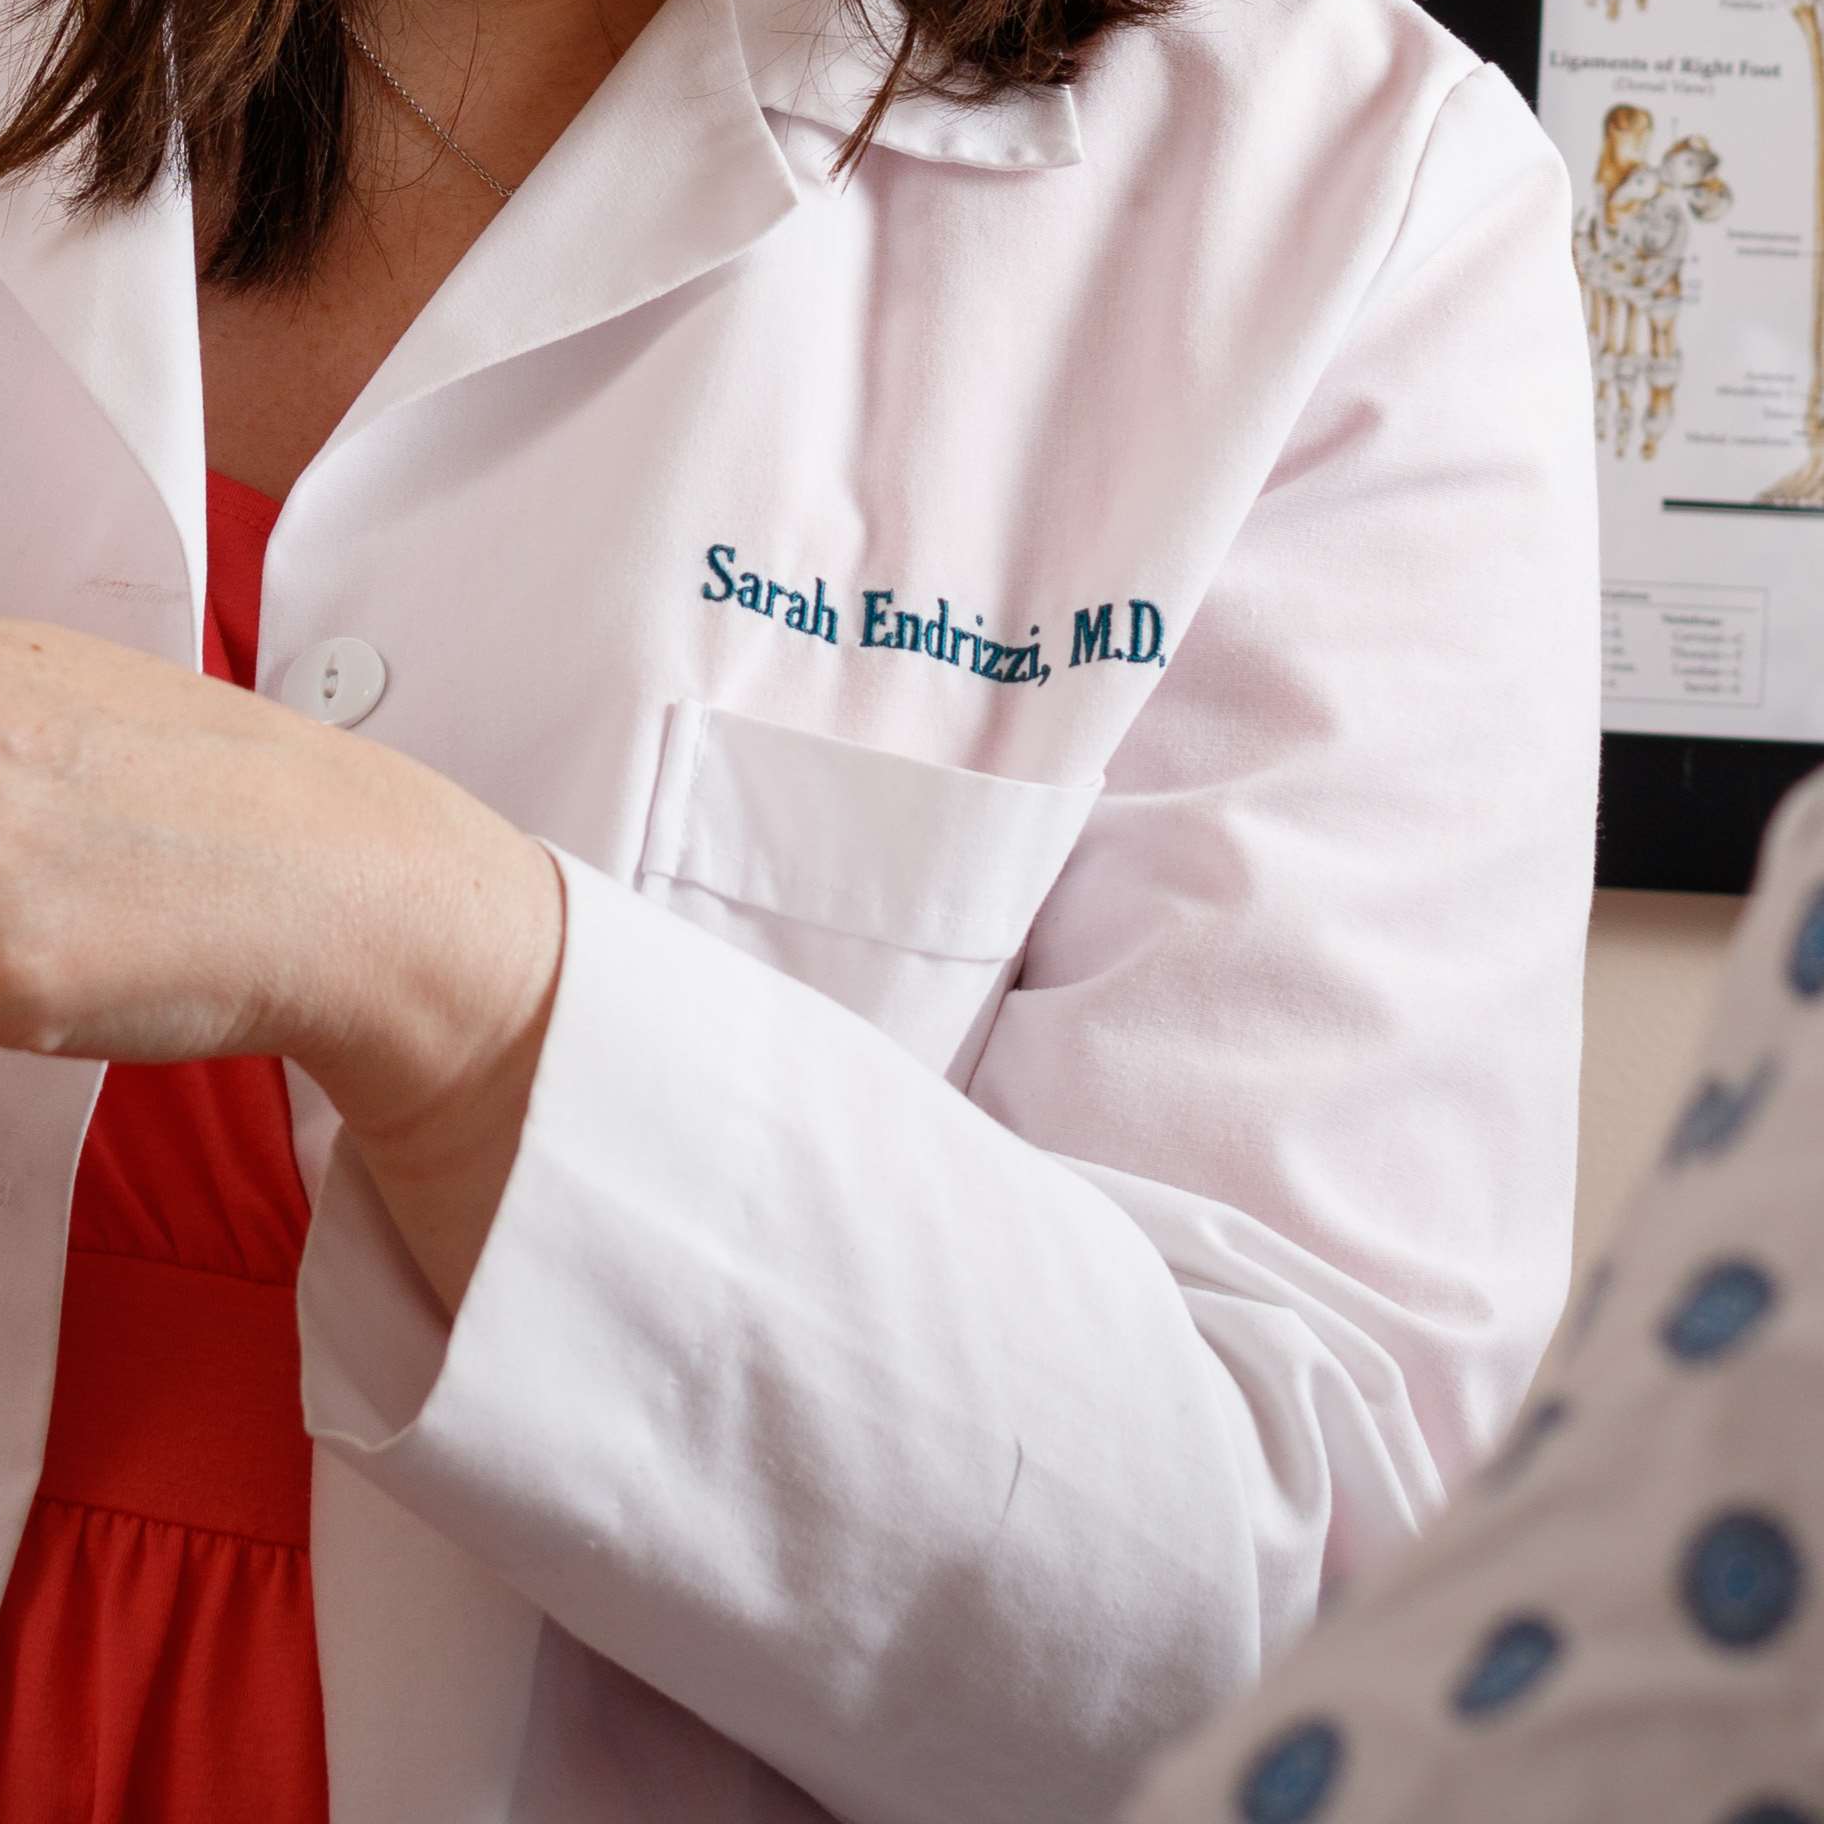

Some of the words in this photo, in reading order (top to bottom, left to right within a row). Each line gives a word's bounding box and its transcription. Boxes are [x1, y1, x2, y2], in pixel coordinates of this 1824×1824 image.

[702, 543, 838, 645] Sarah
[859, 589, 1051, 687] Endrizzi,
[1068, 598, 1167, 669] M.D.
